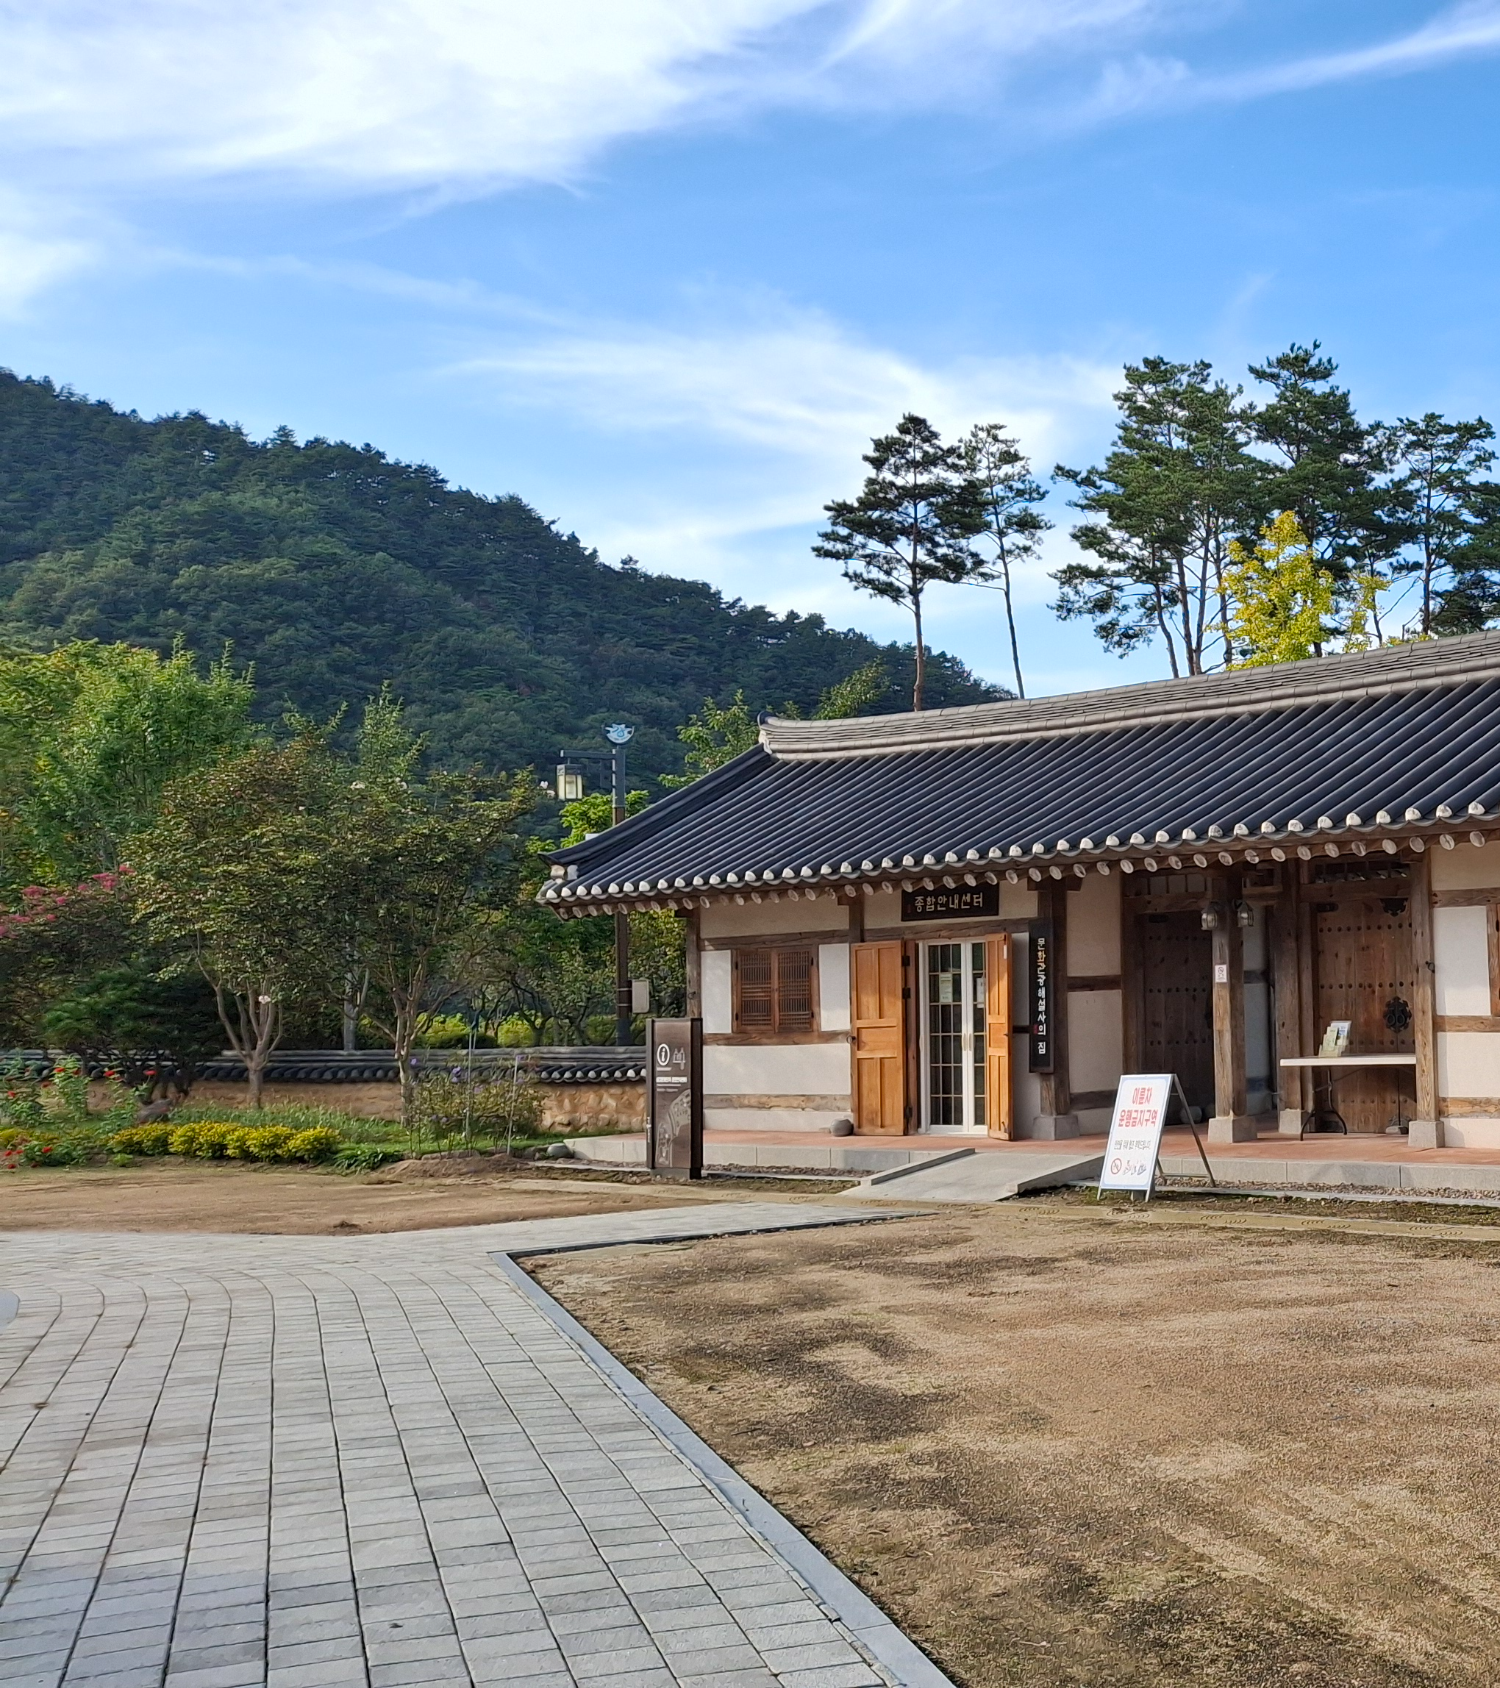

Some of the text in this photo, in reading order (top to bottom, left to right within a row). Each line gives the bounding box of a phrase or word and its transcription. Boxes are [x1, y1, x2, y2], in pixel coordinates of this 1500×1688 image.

[914, 892, 983, 912] 종합안내센터
[1037, 938, 1046, 1054] 문화관광해설사의 집
[1118, 1109, 1159, 1127] 운행금지구역
